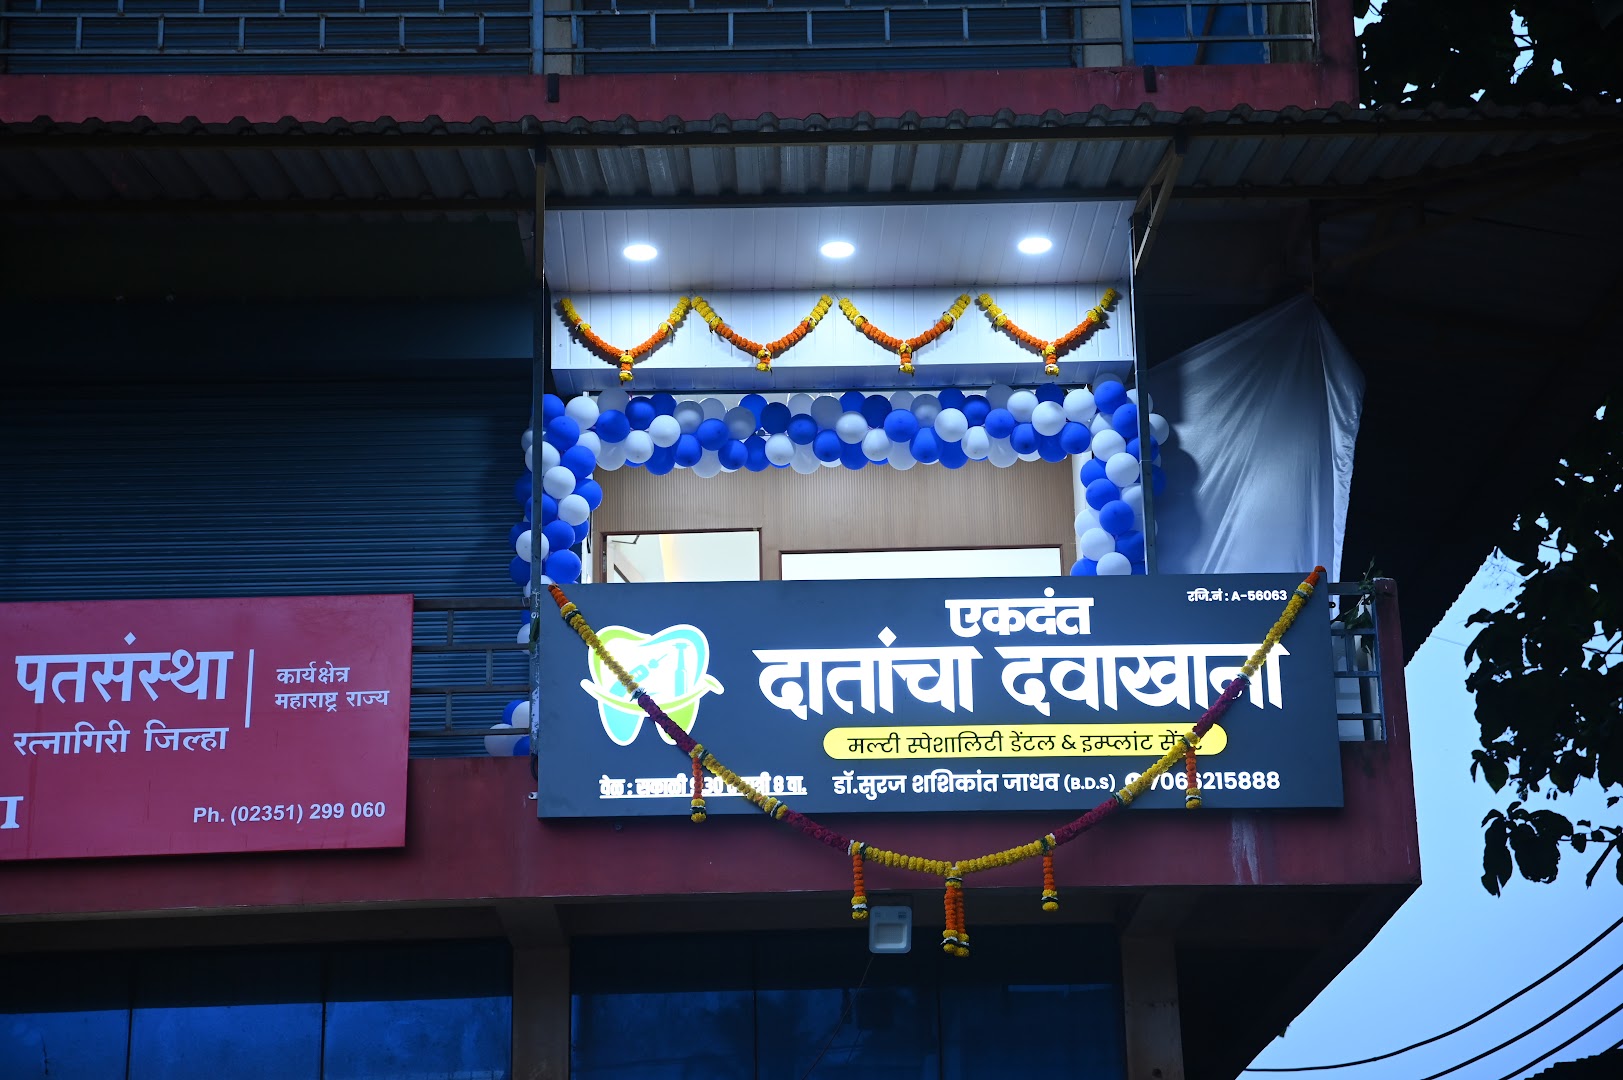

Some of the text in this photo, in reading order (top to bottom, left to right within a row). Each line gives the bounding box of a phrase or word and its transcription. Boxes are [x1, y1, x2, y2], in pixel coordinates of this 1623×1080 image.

[1230, 589, 1288, 602] A-56063
[944, 586, 1095, 638] एकदंत
[14, 631, 235, 704] पतसंस्था
[751, 626, 1291, 721] दातांचा दवाखाना
[274, 689, 391, 713] महाराष्ट्र राज्य
[13, 718, 230, 756] रत्नागिरी जिल्हा
[847, 732, 900, 754] मल्टी
[906, 731, 1003, 753] स्पेशालिटी
[1009, 731, 1056, 752] डेंटल
[1062, 735, 1076, 749] &
[1080, 731, 1153, 752] इम्प्लांट
[773, 775, 784, 794] 8
[911, 768, 1000, 794] शशिकांत
[1001, 773, 1061, 792] जाधव
[1063, 773, 1116, 793] (B.D.S)
[193, 801, 386, 827] Ph. (02351) 299 060
